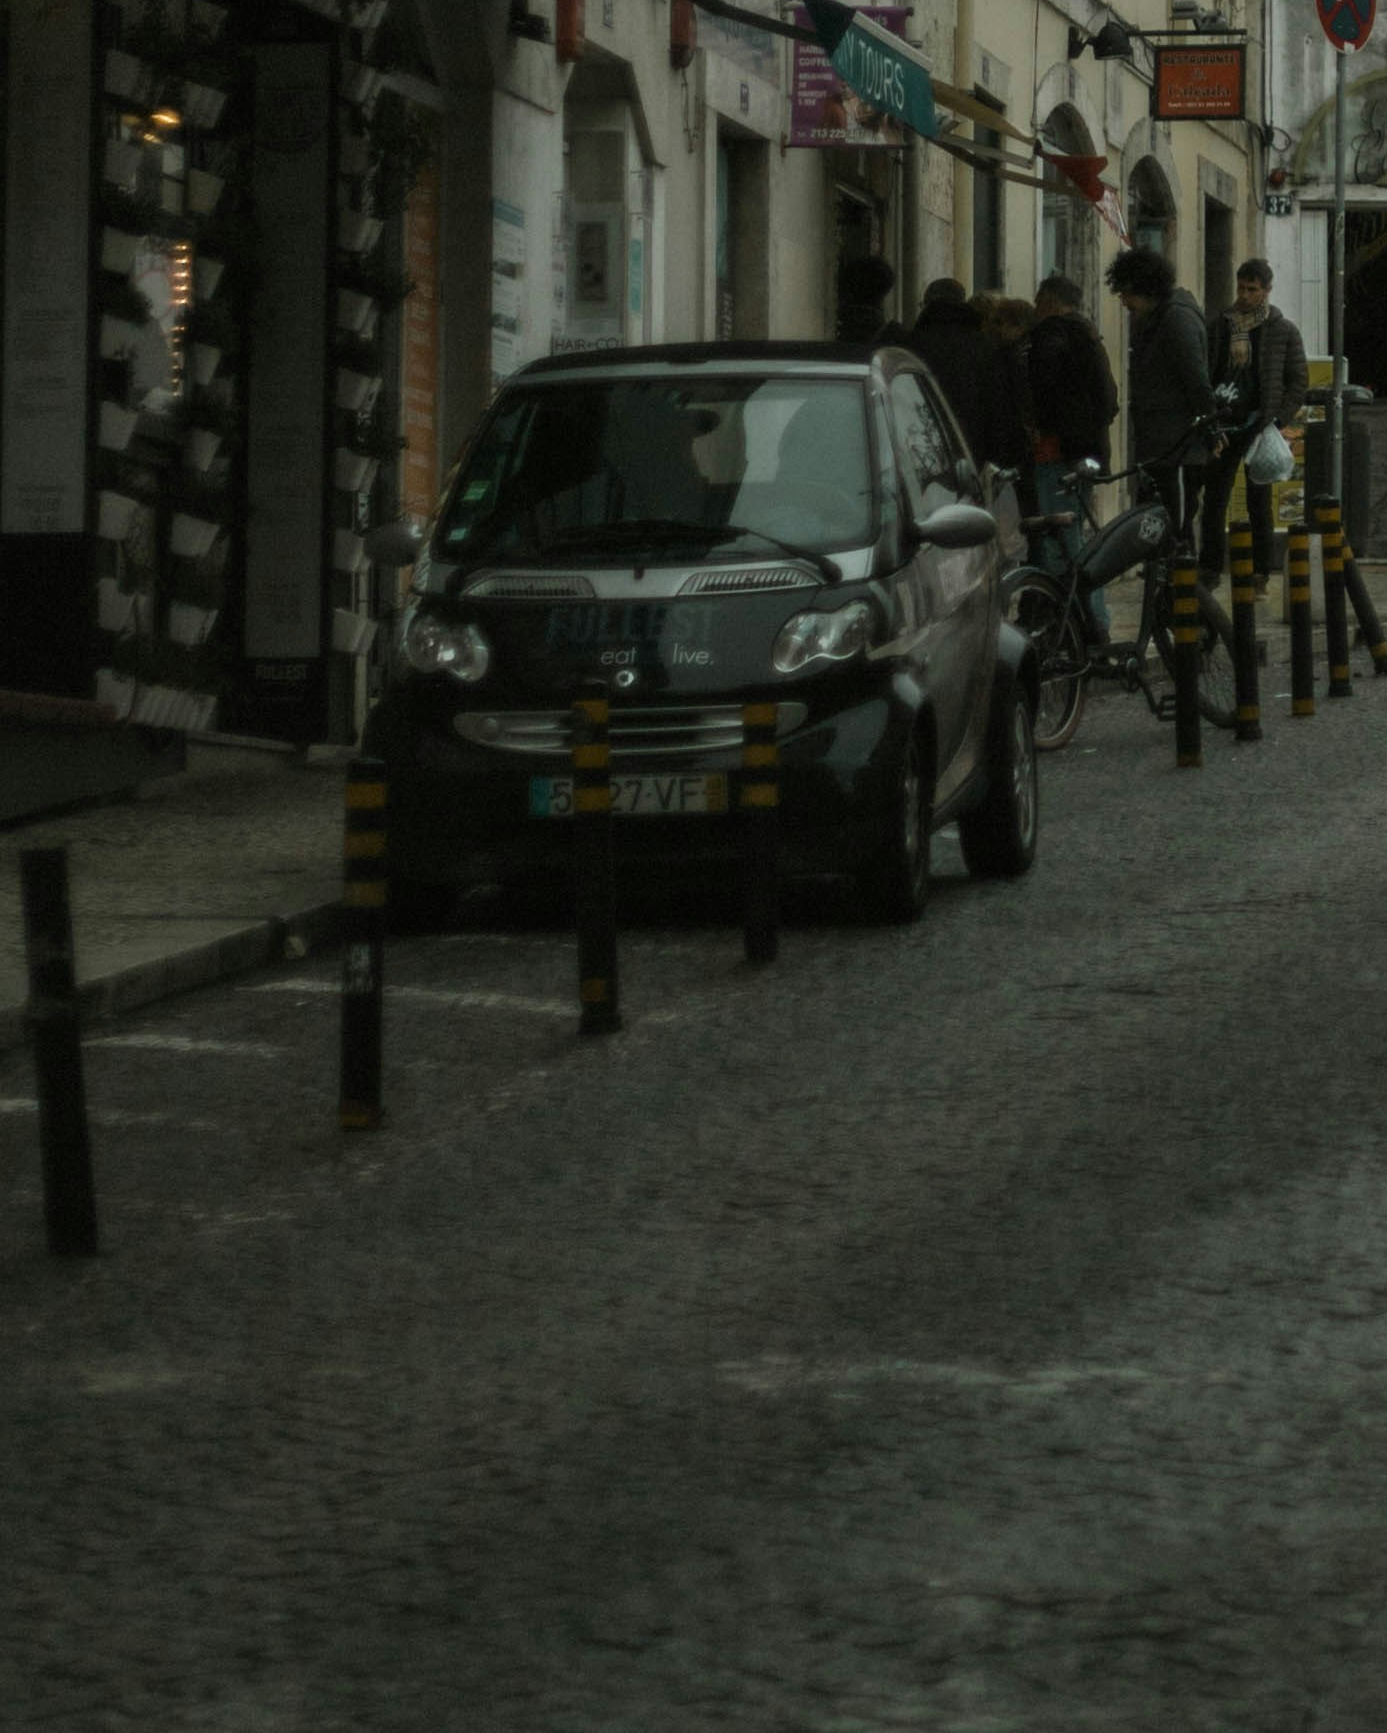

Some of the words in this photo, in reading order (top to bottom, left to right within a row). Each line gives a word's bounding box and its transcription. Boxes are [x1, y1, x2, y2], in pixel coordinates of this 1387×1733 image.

[859, 40, 904, 110] TOURS
[1268, 196, 1287, 212] 37
[600, 646, 638, 666] eat
[672, 643, 715, 666] live.
